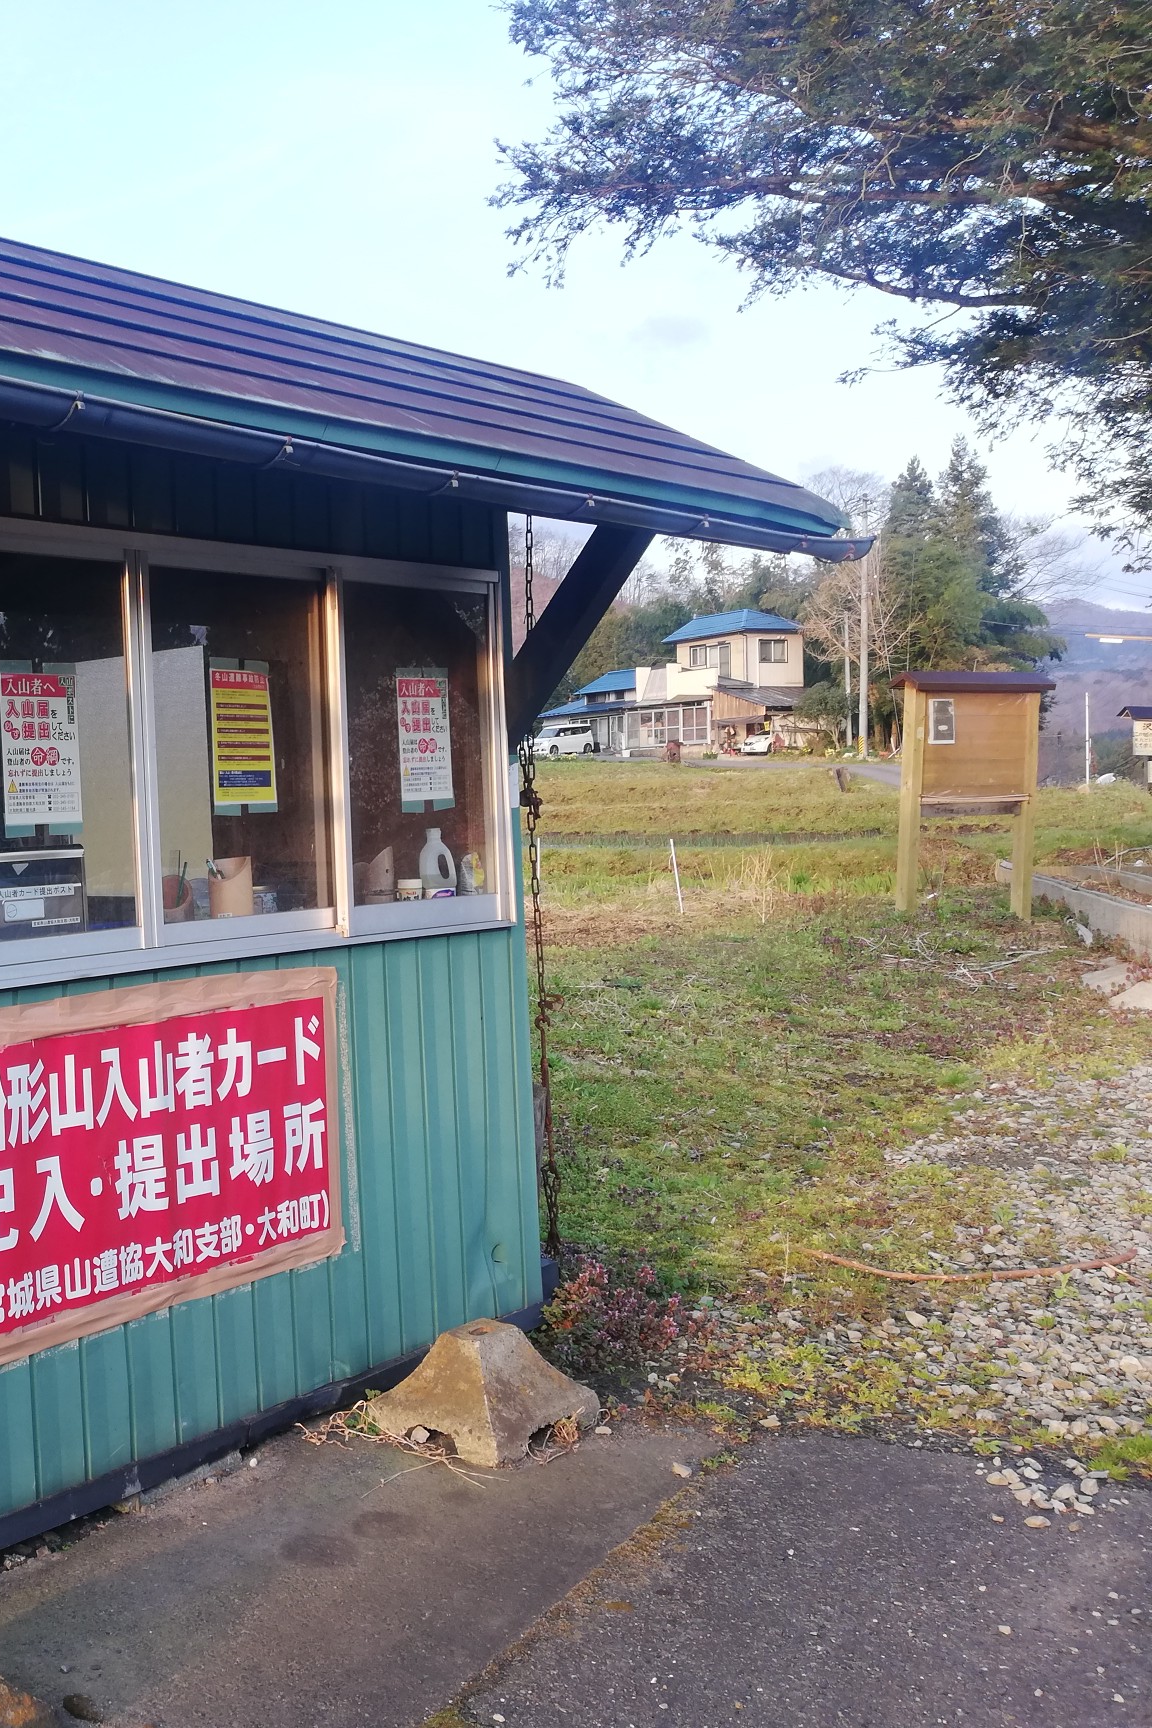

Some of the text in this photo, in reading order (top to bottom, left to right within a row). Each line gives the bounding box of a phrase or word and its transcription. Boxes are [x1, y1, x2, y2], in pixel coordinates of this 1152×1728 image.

[4, 678, 56, 695] 入山者へ
[400, 682, 434, 696] 入山者へ
